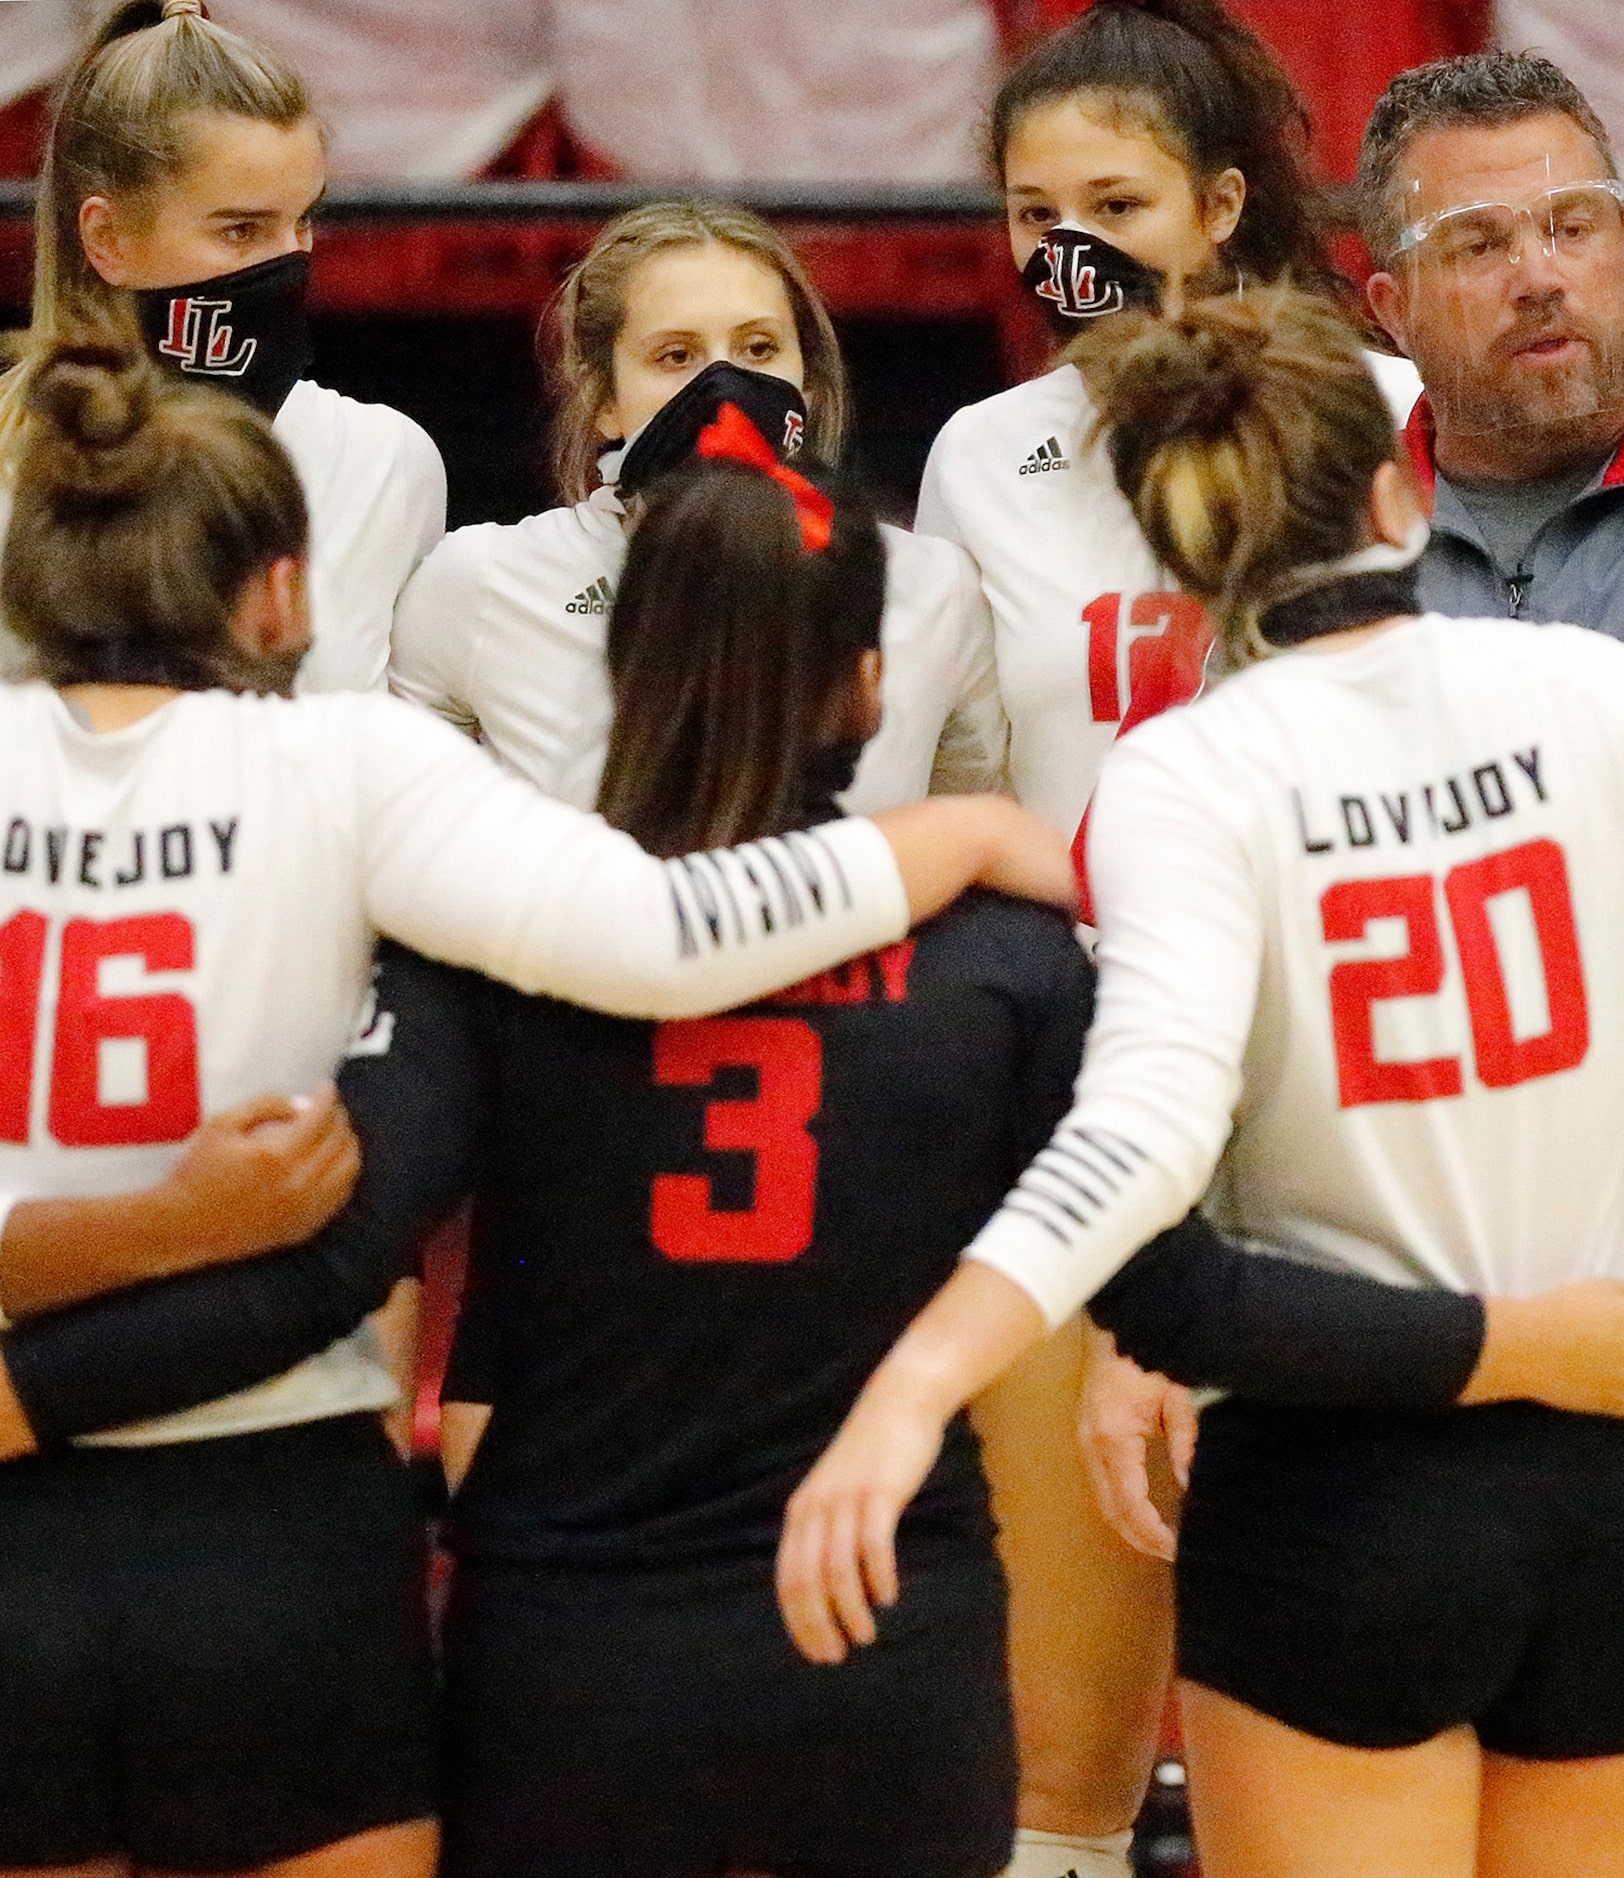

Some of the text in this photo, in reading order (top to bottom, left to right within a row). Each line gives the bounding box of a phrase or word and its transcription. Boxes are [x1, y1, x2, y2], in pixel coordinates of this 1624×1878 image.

[1018, 458, 1071, 475] adidas
[3, 817, 240, 886] OVEJOY
[0, 907, 203, 1149] 16
[1319, 837, 1591, 1110] 20
[650, 1016, 823, 1263] 3
